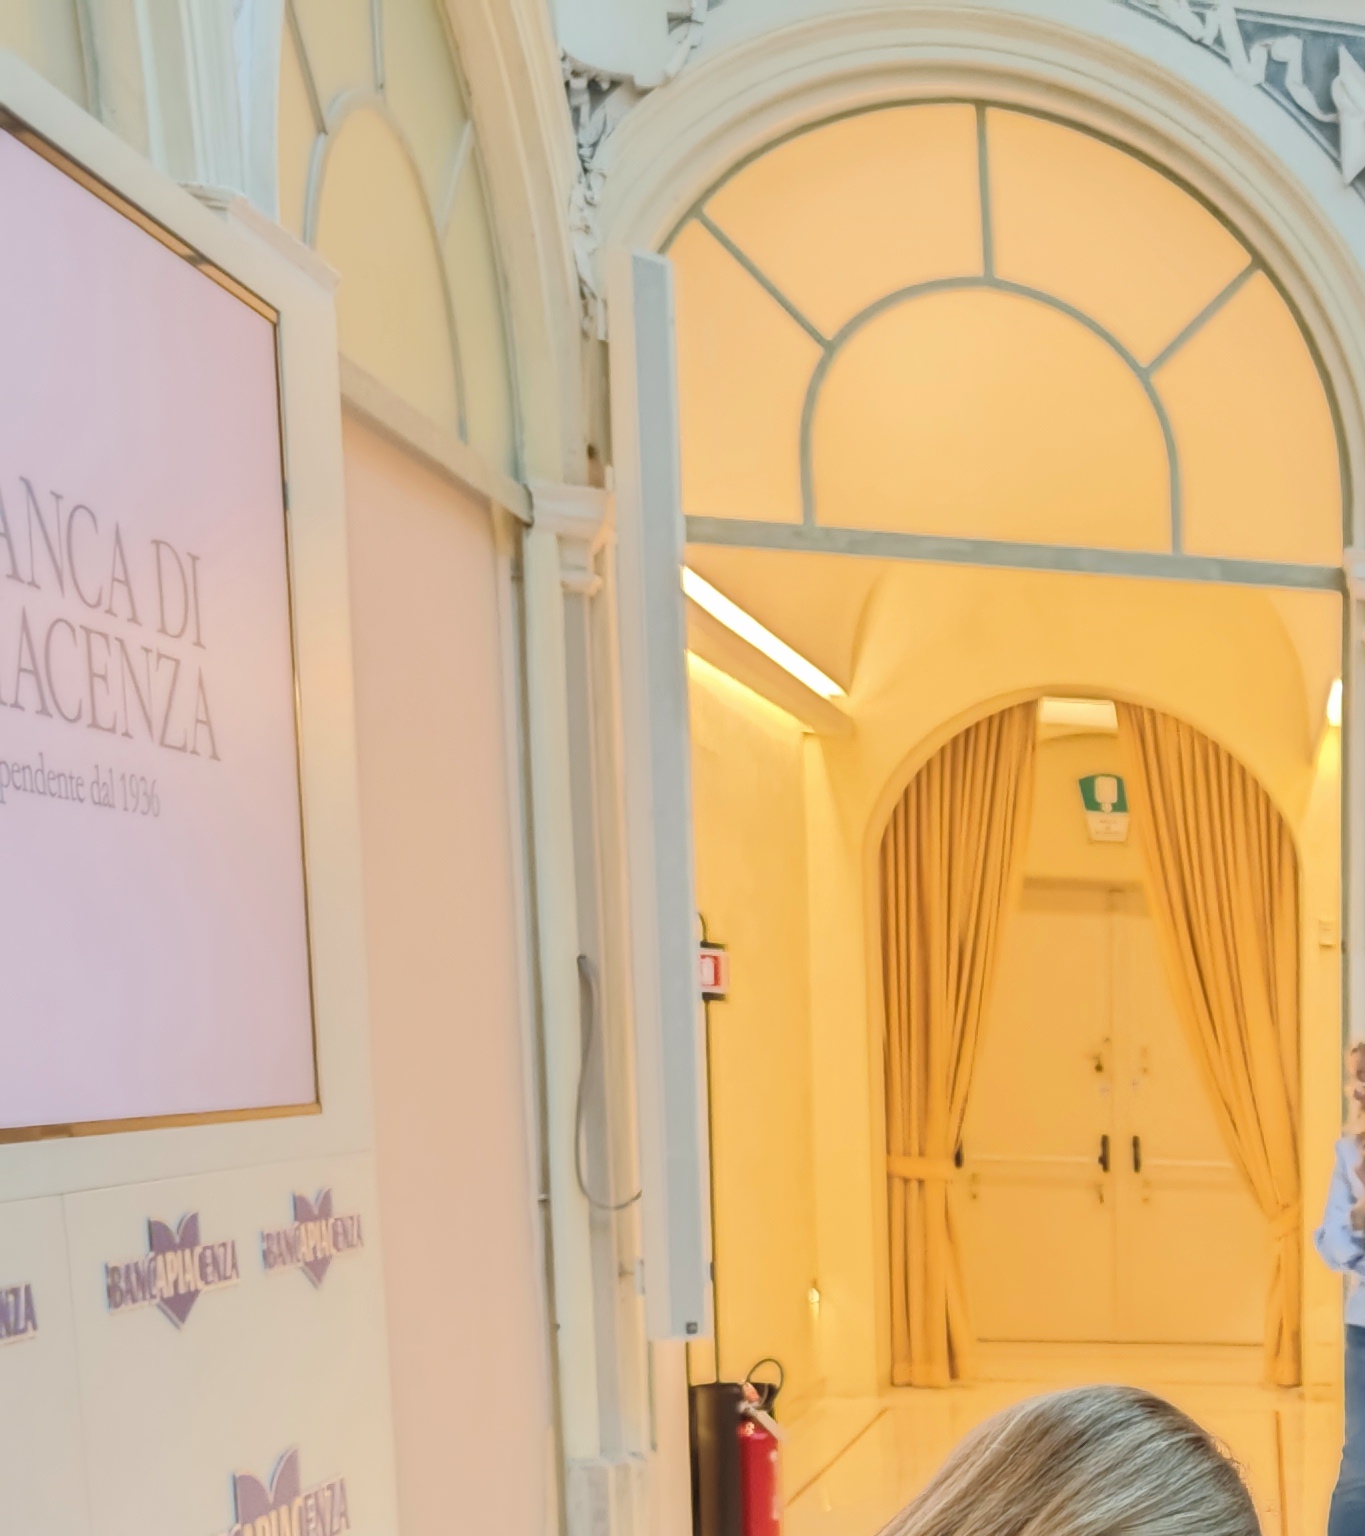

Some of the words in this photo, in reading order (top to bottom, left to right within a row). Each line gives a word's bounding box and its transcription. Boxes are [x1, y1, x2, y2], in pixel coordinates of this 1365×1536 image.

[151, 539, 206, 650] DI
[0, 606, 222, 762] ACENZA
[90, 765, 116, 809] dal
